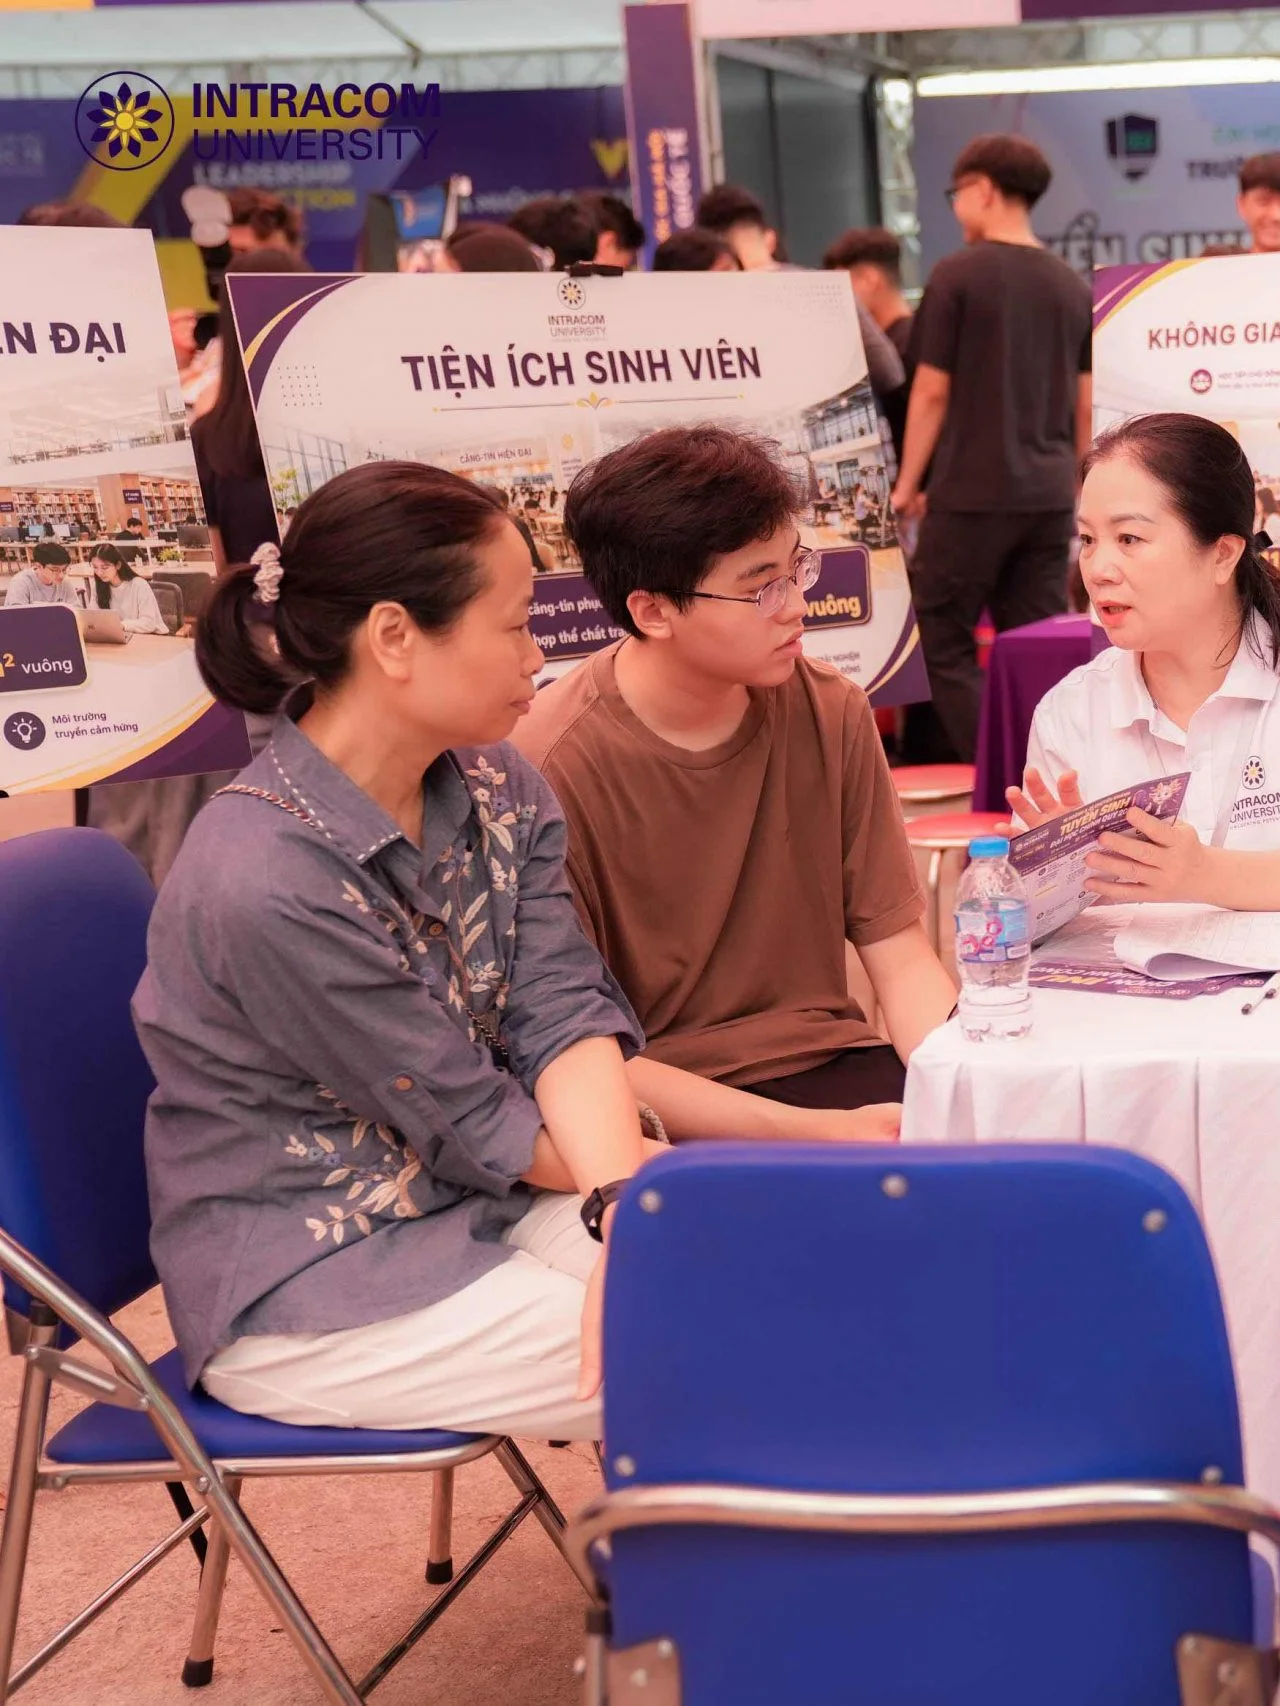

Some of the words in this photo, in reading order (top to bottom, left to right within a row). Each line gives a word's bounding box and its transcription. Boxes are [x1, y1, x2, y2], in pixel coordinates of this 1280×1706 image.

[548, 315, 605, 326] INTRACOM
[550, 326, 607, 337] UNIVERSITY
[1148, 321, 1236, 350] KHÔNG
[48, 322, 126, 363] ĐẠI
[401, 345, 495, 398] TIỆN
[507, 343, 575, 388] ÍCH
[585, 349, 672, 385] SINH
[680, 338, 763, 381] VIÊN
[528, 599, 575, 617] căng-tin
[807, 592, 861, 618] vuông
[532, 632, 556, 649] hợp
[558, 626, 578, 644] thể
[581, 624, 606, 641] chất
[608, 626, 627, 639] tra
[21, 658, 73, 675] vuông
[52, 714, 71, 725] Môi
[73, 711, 107, 723] trường
[55, 726, 87, 739] truyền
[90, 724, 111, 736] cảm
[113, 722, 139, 734] hứng
